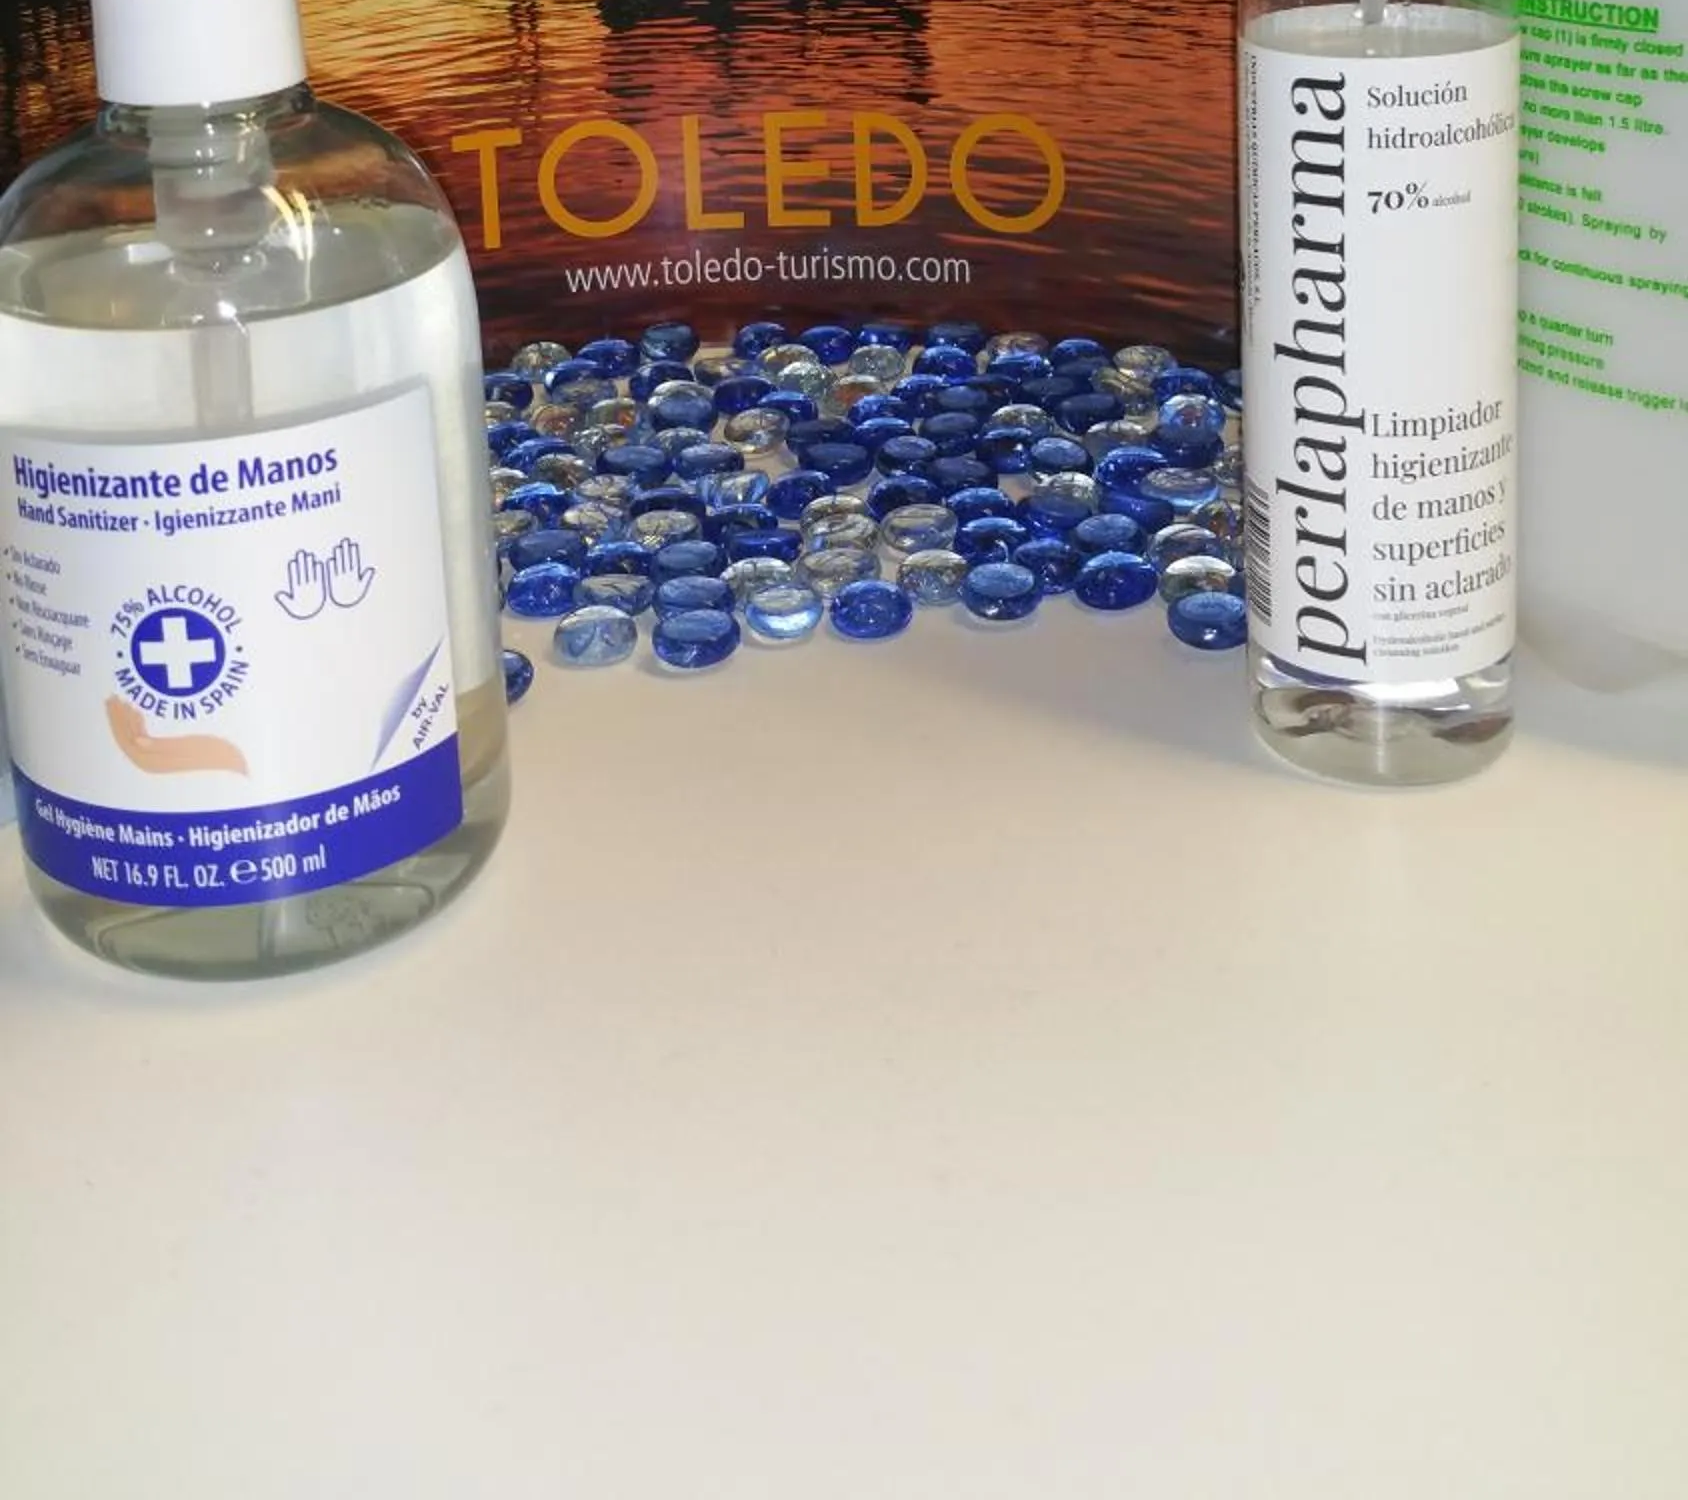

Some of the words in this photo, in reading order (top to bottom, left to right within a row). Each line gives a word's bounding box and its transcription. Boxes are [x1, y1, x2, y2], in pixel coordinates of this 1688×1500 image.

[1633, 39, 1684, 57] closed
[1367, 80, 1468, 109] Solución
[1615, 92, 1643, 109] cap
[1547, 130, 1606, 153] develops
[451, 110, 1066, 249] TOLEDO
[1366, 181, 1430, 215] 70%
[1582, 213, 1641, 240] Spraying
[1650, 226, 1667, 244] by
[565, 246, 971, 293] www.toledo-turismo.com
[1552, 259, 1623, 285] continuous
[1273, 72, 1367, 667] perlapharma
[1547, 368, 1569, 385] and
[1572, 376, 1623, 400] release
[1626, 388, 1676, 411] trigger
[1371, 399, 1503, 441] Limpiador
[13, 453, 182, 499] Higienizante
[190, 463, 229, 496] de
[238, 448, 338, 490] Manos
[1370, 433, 1513, 485] higienizante
[17, 496, 55, 525] Hand
[57, 506, 139, 532] Sanitizer
[154, 499, 287, 536] Igienizzante
[291, 481, 342, 514] Mani
[1372, 494, 1408, 521] de
[1416, 483, 1496, 520] manos
[1372, 520, 1506, 567] superficies
[1372, 576, 1417, 602] sin
[1425, 551, 1511, 601] aclarado
[110, 598, 145, 638] 75%
[146, 584, 243, 635] ALCOHOL
[115, 668, 168, 718] MADE
[173, 701, 196, 720] IN
[200, 660, 250, 715] SPAIN
[411, 696, 427, 719] by
[35, 799, 54, 825] Gel
[54, 806, 116, 842] Hygiène
[118, 824, 175, 848] Mains
[187, 812, 321, 852] Higienizador
[324, 803, 350, 826] de
[352, 784, 402, 818] Mãos
[91, 855, 121, 883] NET
[124, 861, 159, 887] 16.9
[163, 864, 189, 888] FL.
[193, 863, 225, 888] OZ.
[302, 843, 328, 874] ml
